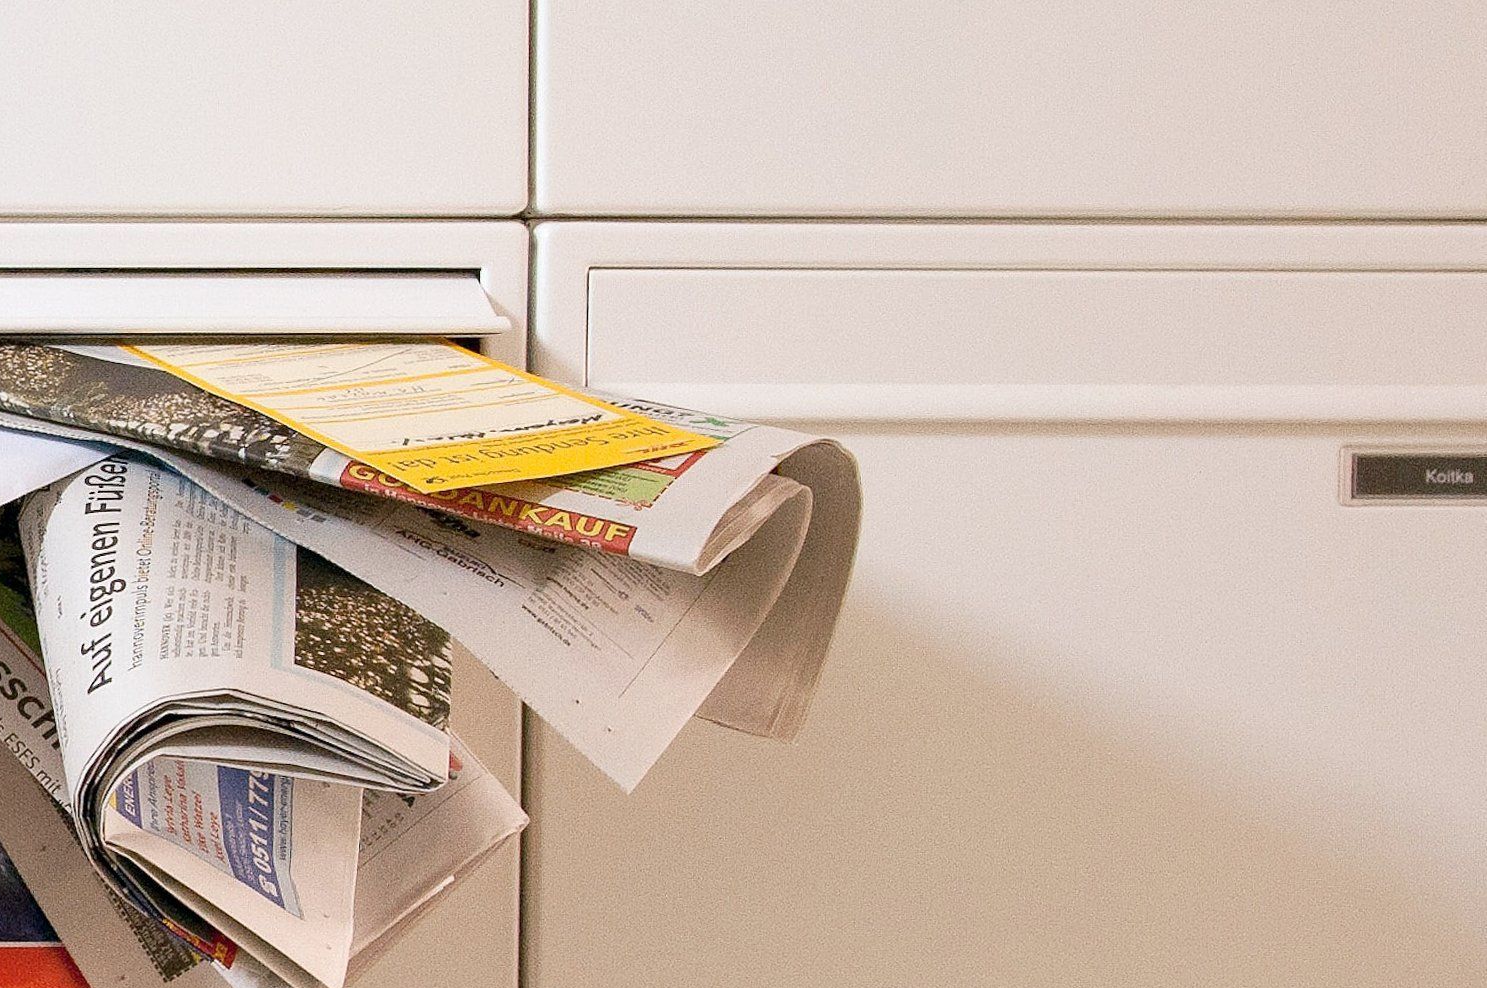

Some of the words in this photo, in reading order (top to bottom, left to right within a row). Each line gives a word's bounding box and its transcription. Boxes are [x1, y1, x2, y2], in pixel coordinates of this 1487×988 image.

[443, 452, 483, 465] ist
[480, 435, 610, 459] Sendung
[616, 426, 670, 440] Ihre
[348, 464, 630, 541] GODANKAUF
[80, 521, 128, 628] eigenen
[135, 556, 151, 582] bietet
[128, 582, 152, 671] hannoverimpuls
[81, 632, 113, 695] Auf
[3, 733, 42, 772] ESFS
[36, 769, 63, 795] mit
